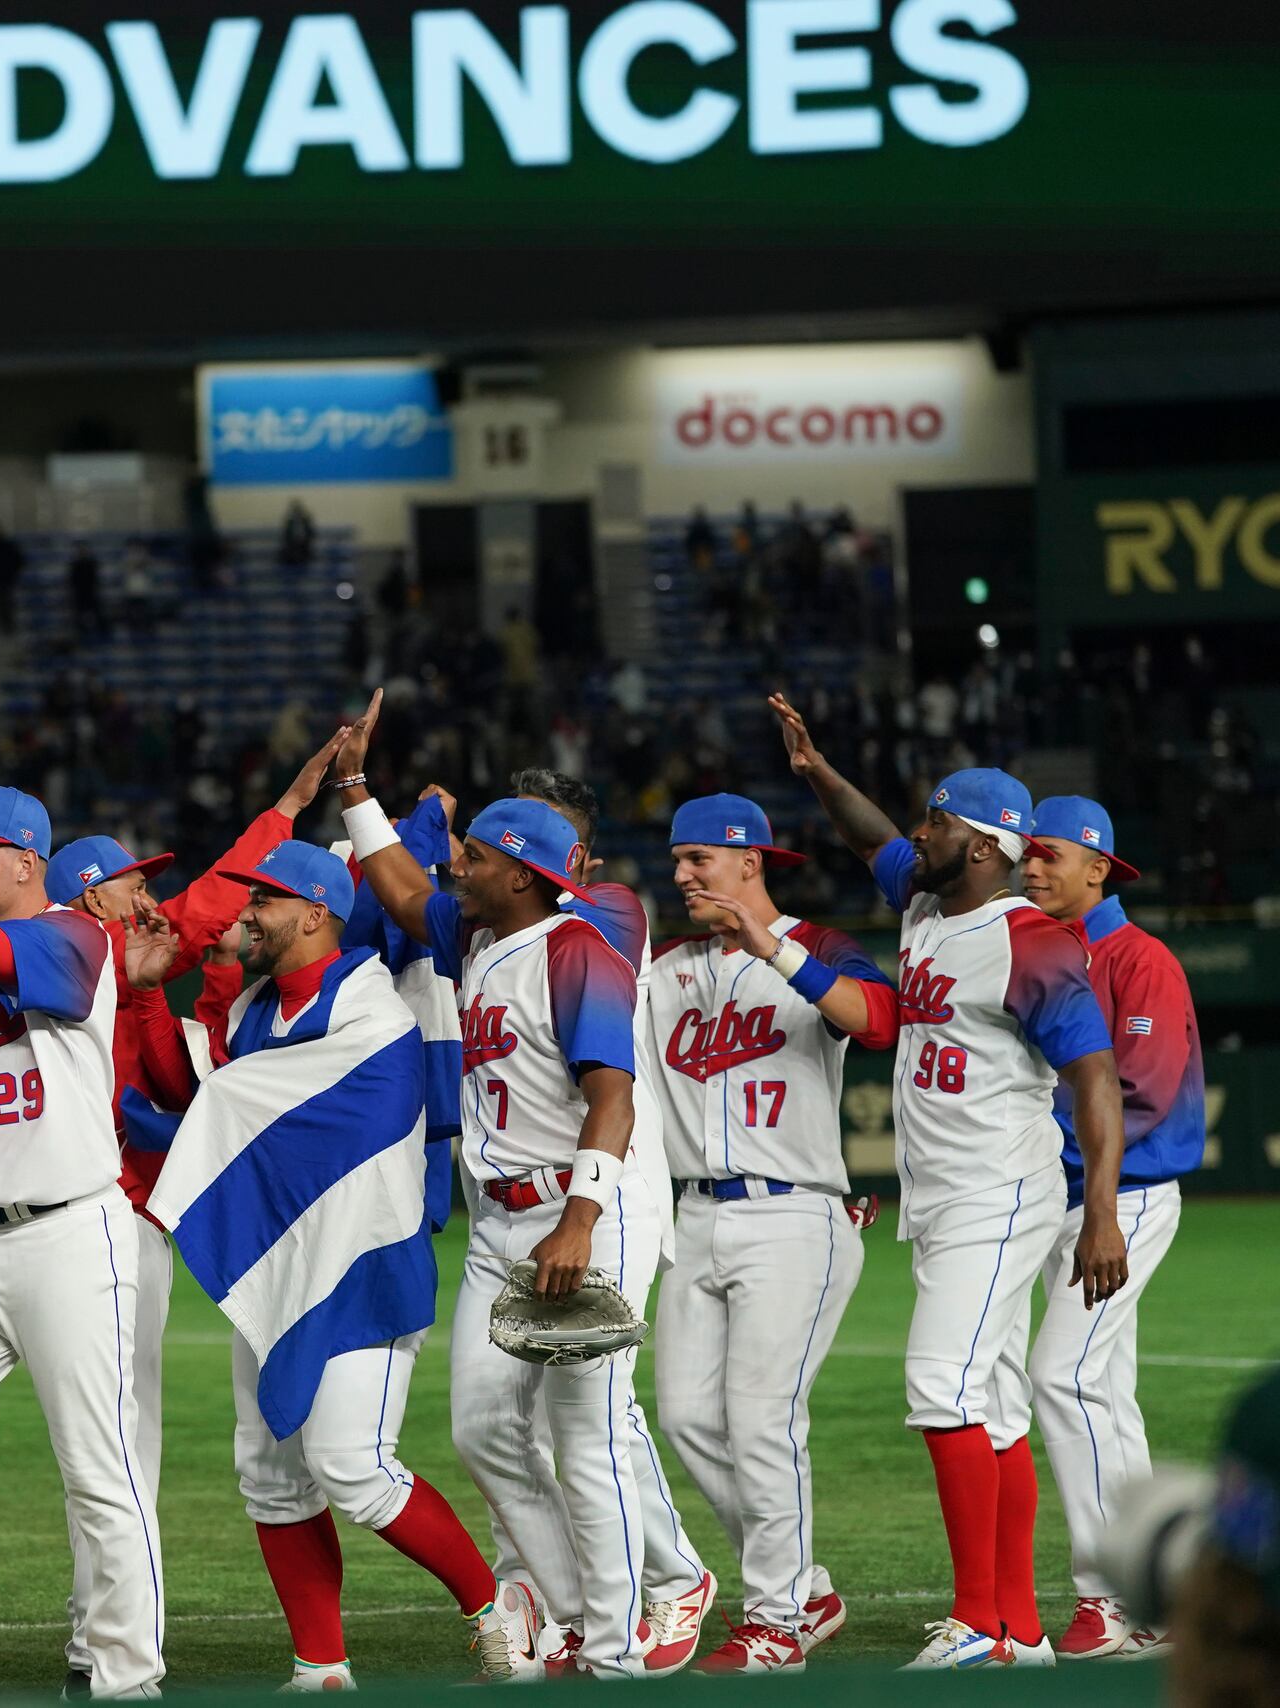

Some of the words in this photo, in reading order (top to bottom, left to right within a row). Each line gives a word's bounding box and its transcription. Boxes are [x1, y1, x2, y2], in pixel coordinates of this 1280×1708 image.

[676, 392, 944, 448] docomo
[460, 992, 518, 1064] uba
[665, 999, 787, 1080] Cuba
[913, 1040, 968, 1095] 98
[487, 1079, 509, 1131] 7
[743, 1080, 787, 1128] 17
